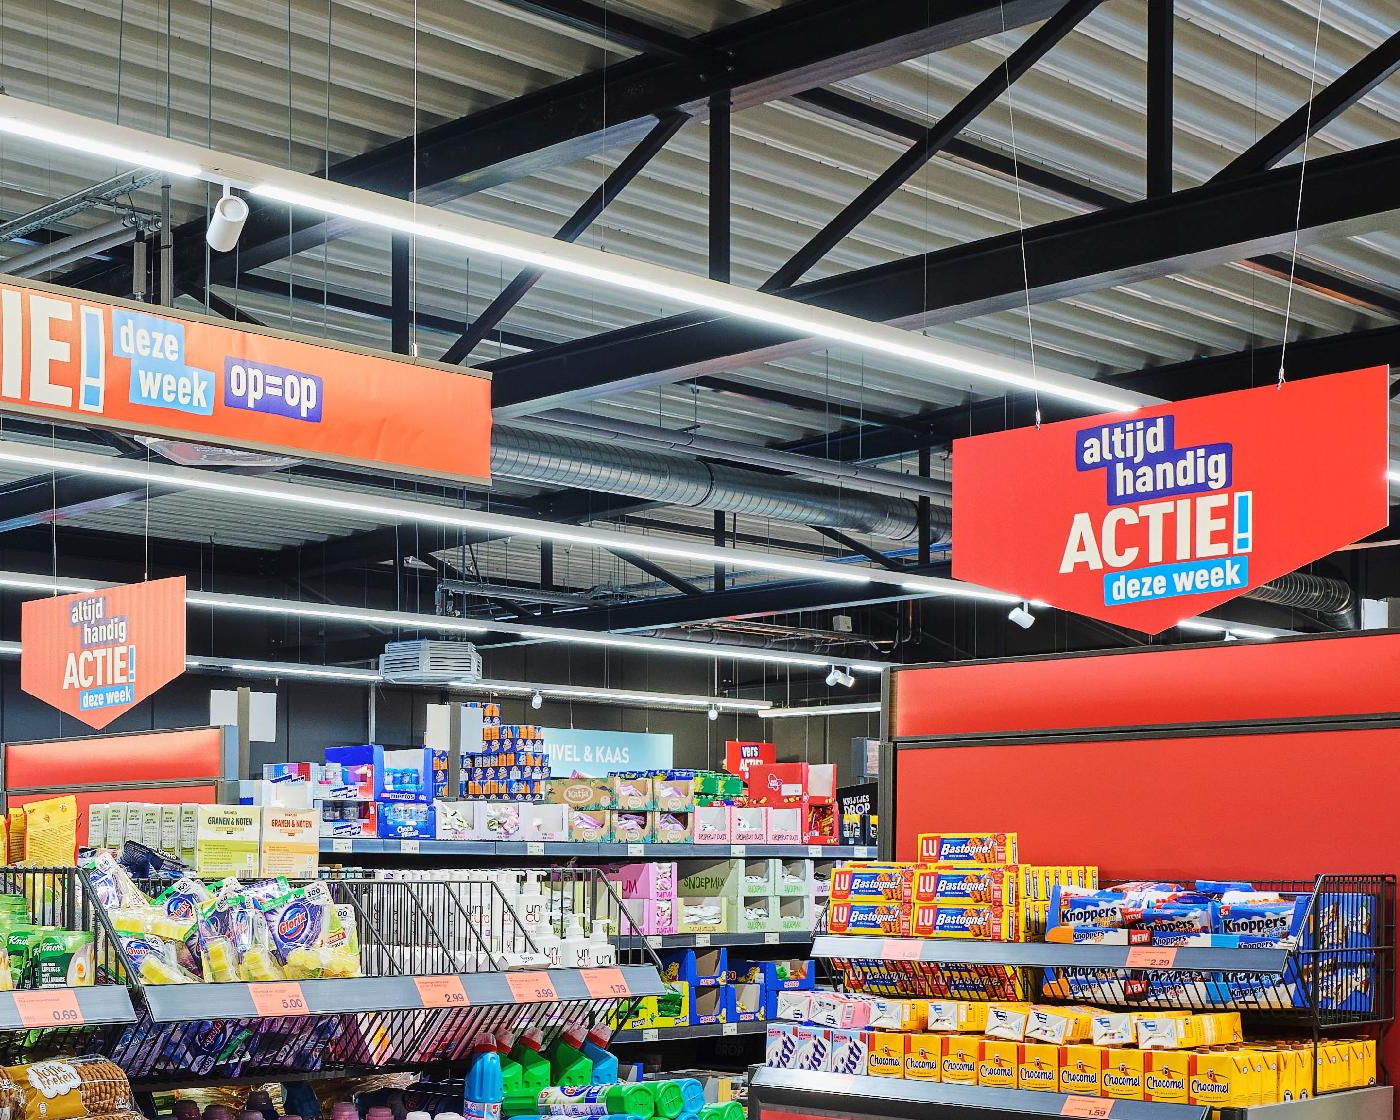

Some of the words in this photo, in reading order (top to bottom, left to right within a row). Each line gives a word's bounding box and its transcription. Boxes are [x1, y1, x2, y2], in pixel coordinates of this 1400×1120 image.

[120, 319, 180, 361] deze
[138, 369, 208, 407] week
[230, 364, 318, 418] op=op
[1082, 417, 1164, 465] altijd
[1116, 448, 1226, 496] handig
[1059, 490, 1253, 574] ACTIE!
[1112, 572, 1167, 600] deze
[1173, 560, 1241, 593] week
[71, 597, 103, 624] altijd
[84, 618, 127, 644] handig
[62, 645, 136, 690] ACTIE!
[83, 691, 104, 709] deze
[106, 686, 132, 705] week
[595, 746, 630, 765] KAAS
[843, 803, 871, 815] DROP
[923, 839, 938, 857] LU
[941, 840, 992, 855] Bastogne!
[684, 876, 725, 889] SNOEPMIX
[834, 874, 850, 892] LU
[851, 878, 901, 891] Bastogne!
[919, 875, 935, 893] LU
[936, 880, 988, 893] Bastogne!
[306, 888, 322, 898] 300
[833, 906, 848, 923] LU
[850, 911, 899, 924] Bastogne!
[918, 907, 934, 926] LU
[936, 912, 988, 927] Bastogne!
[1061, 906, 1117, 923] Knoppers
[278, 912, 307, 935] Glorix
[1222, 916, 1287, 934] Knoppers
[1073, 929, 1105, 940] Knoppers
[1131, 933, 1150, 943] NEW
[1152, 935, 1186, 946] Knoppers
[1149, 958, 1170, 967] 2.29
[535, 988, 554, 998] 3.99
[611, 984, 627, 994] 1.79
[282, 998, 303, 1009] 5.00
[444, 993, 464, 1003] 2.99
[52, 1009, 78, 1021] 0.69
[870, 1053, 901, 1067] Chocomel
[905, 1057, 937, 1070] Chocomel
[942, 1058, 975, 1073] Chocomel
[980, 1065, 1014, 1078] Chocomel
[1020, 1067, 1055, 1081] Chocomel
[1061, 1069, 1098, 1084] Chocomel
[1103, 1073, 1141, 1088] Chocomel
[1147, 1074, 1185, 1090] Chocomel
[1192, 1077, 1229, 1094] Chocomel
[1088, 1108, 1107, 1117] 1.59
